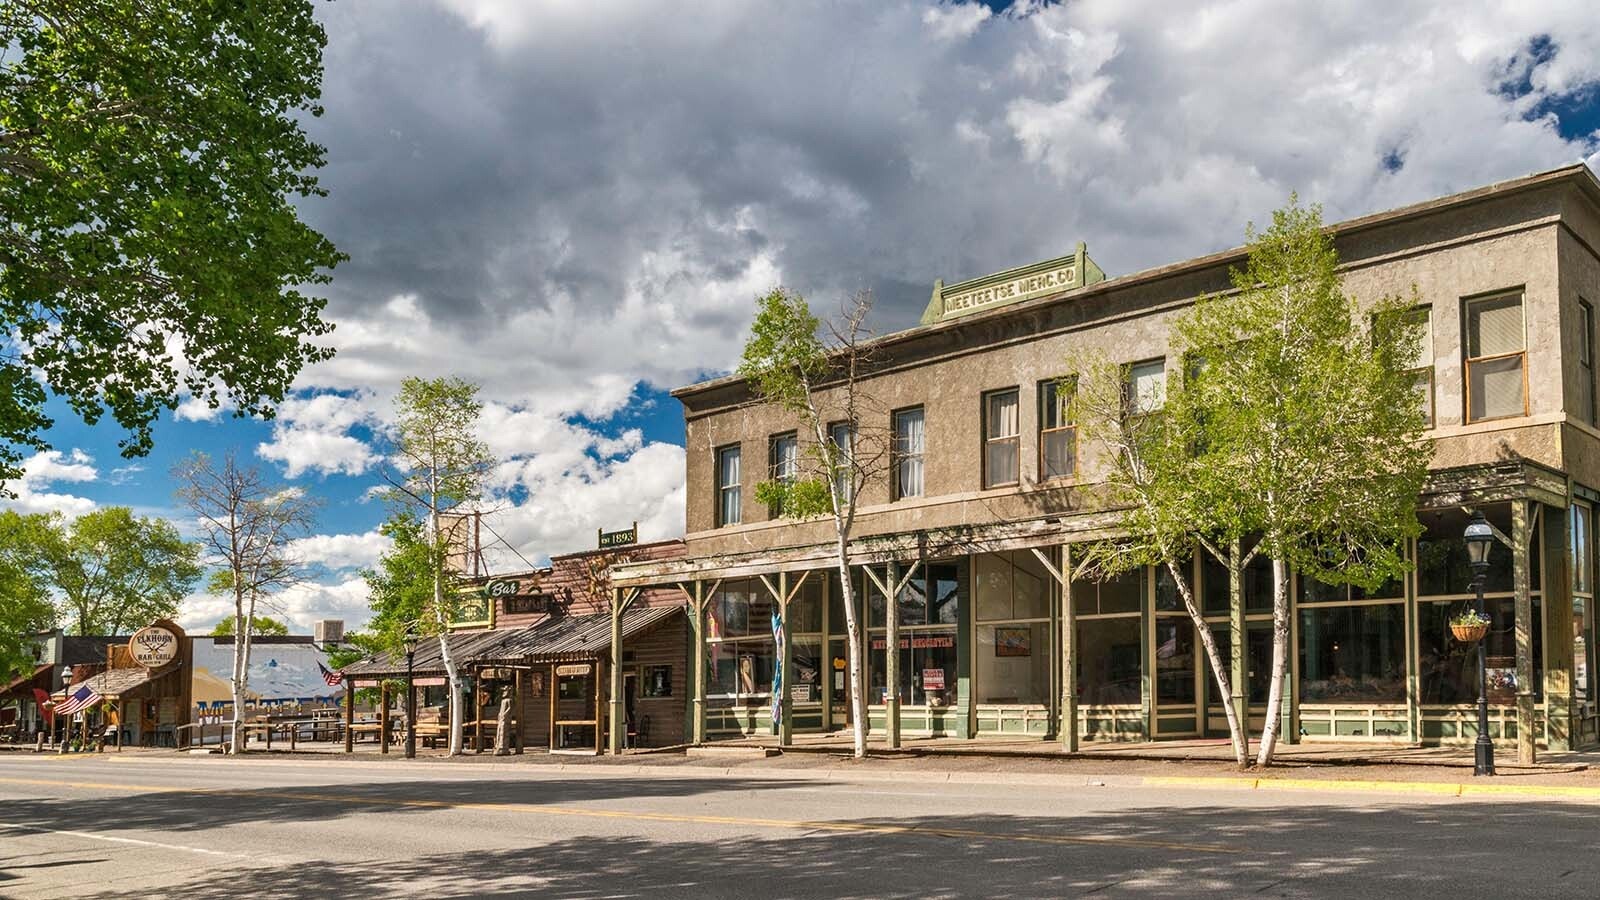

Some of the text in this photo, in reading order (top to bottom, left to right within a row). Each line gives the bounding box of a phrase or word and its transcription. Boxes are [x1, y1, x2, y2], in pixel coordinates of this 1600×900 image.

[945, 283, 1015, 312] MEETEETSE
[612, 532, 633, 544] 1893
[491, 582, 517, 597] Bar
[137, 634, 173, 644] ELKHORN
[156, 653, 171, 661] GRILL
